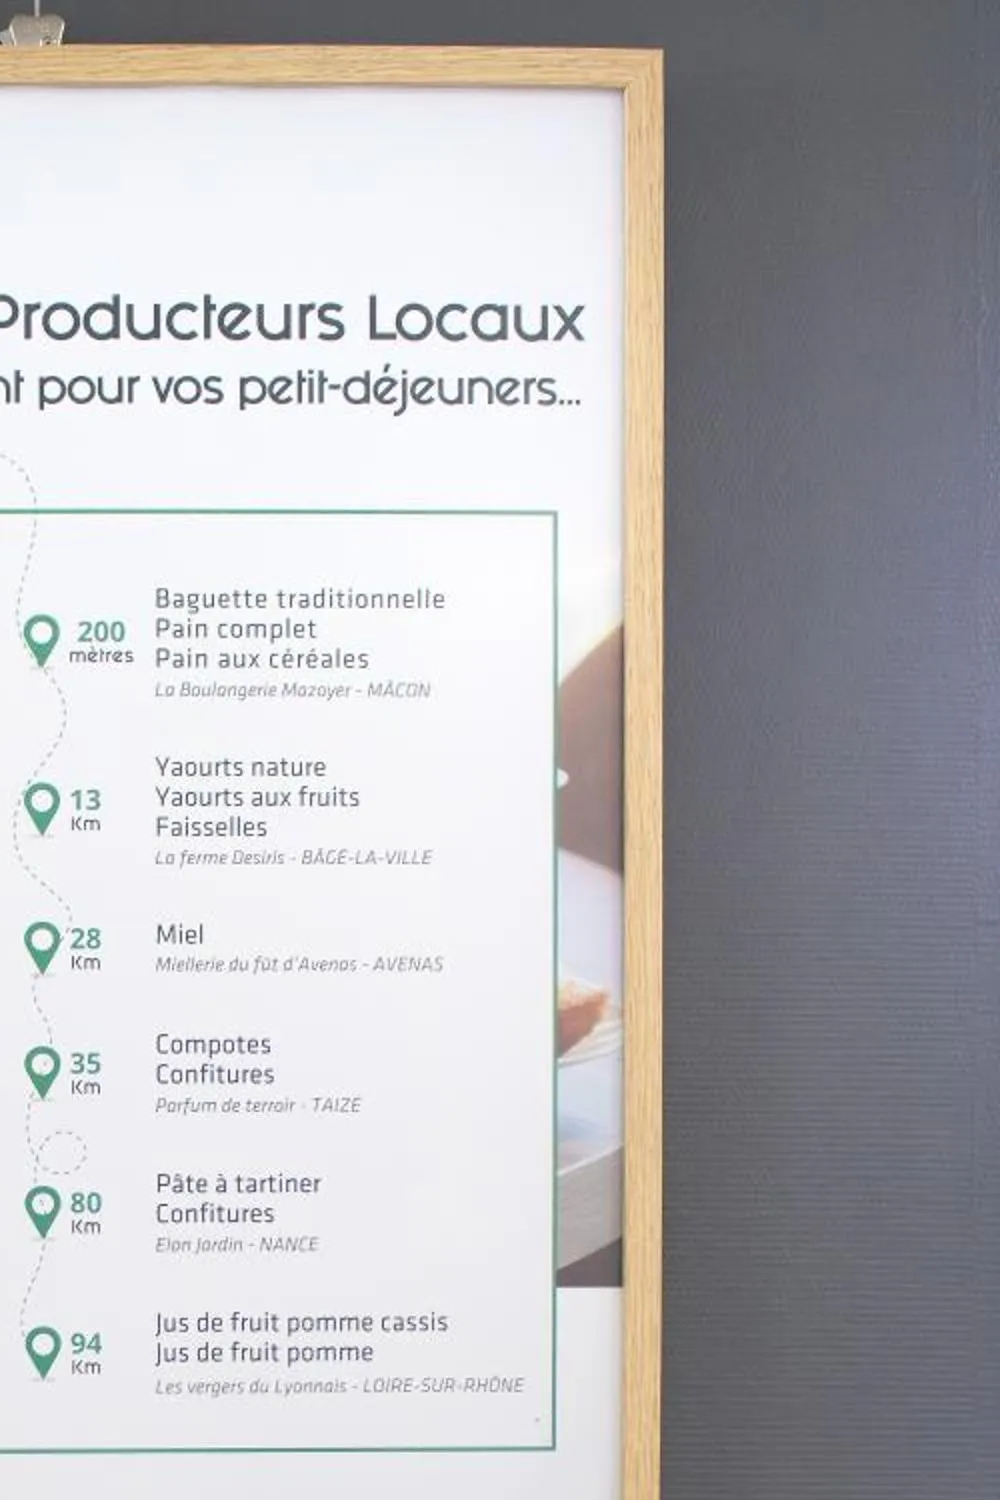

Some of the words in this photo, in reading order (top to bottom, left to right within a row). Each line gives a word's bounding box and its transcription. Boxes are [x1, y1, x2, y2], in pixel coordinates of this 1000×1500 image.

[369, 295, 584, 342] Locaux
[39, 376, 140, 411] pour
[152, 376, 224, 404] vos
[156, 588, 267, 614] Baguette
[276, 588, 444, 608] traditionnelle
[77, 620, 126, 643] 200
[156, 618, 208, 638] Pain
[217, 618, 316, 642] complet
[70, 646, 134, 663] mètres
[156, 648, 208, 668] Pain
[218, 653, 260, 668] aux
[269, 648, 368, 669] céréales
[155, 683, 175, 697] La
[179, 681, 277, 701] Boulangerie
[368, 680, 430, 698] MÂCON
[155, 757, 243, 777] Yaourts
[252, 758, 326, 777] nature
[71, 789, 101, 810] 13
[156, 786, 244, 807] Yaourts
[251, 791, 291, 807] aux
[299, 786, 359, 807] fruits
[72, 816, 101, 830] Km
[156, 816, 267, 837] Faisselles
[155, 851, 175, 865] La
[180, 849, 228, 869] ferme
[71, 928, 102, 950] 28
[157, 923, 203, 944] Miel
[72, 956, 100, 970] Km
[156, 957, 225, 972] Miellerie
[229, 957, 249, 972] du
[373, 956, 443, 972] AVENAS
[156, 1034, 271, 1059] Compotes
[71, 1053, 100, 1074] 35
[156, 1063, 274, 1085] Confitures
[72, 1080, 100, 1094] Km
[155, 1098, 217, 1116] Parfum
[221, 1098, 241, 1113] de
[246, 1098, 296, 1113] terroir
[157, 1174, 207, 1194] Pâte
[216, 1174, 227, 1193] à
[235, 1173, 321, 1193] tartiner
[70, 1192, 102, 1214] 80
[156, 1202, 274, 1224] Confitures
[72, 1219, 100, 1234] Km
[195, 1236, 243, 1254] Jardin
[259, 1236, 318, 1252] NANCE
[155, 1313, 189, 1337] Jus
[197, 1312, 223, 1332] de
[230, 1312, 279, 1332] fruit
[288, 1316, 373, 1337] pomme
[381, 1312, 448, 1332] cassis
[71, 1333, 102, 1354] 94
[155, 1342, 189, 1367] Jus
[197, 1342, 223, 1362] de
[230, 1341, 279, 1362] fruit
[288, 1346, 373, 1367] pomme
[72, 1360, 101, 1374] Km
[156, 1380, 182, 1394] Les
[188, 1379, 244, 1397] vergers
[250, 1379, 269, 1393] du
[275, 1379, 347, 1397] Lyonnais
